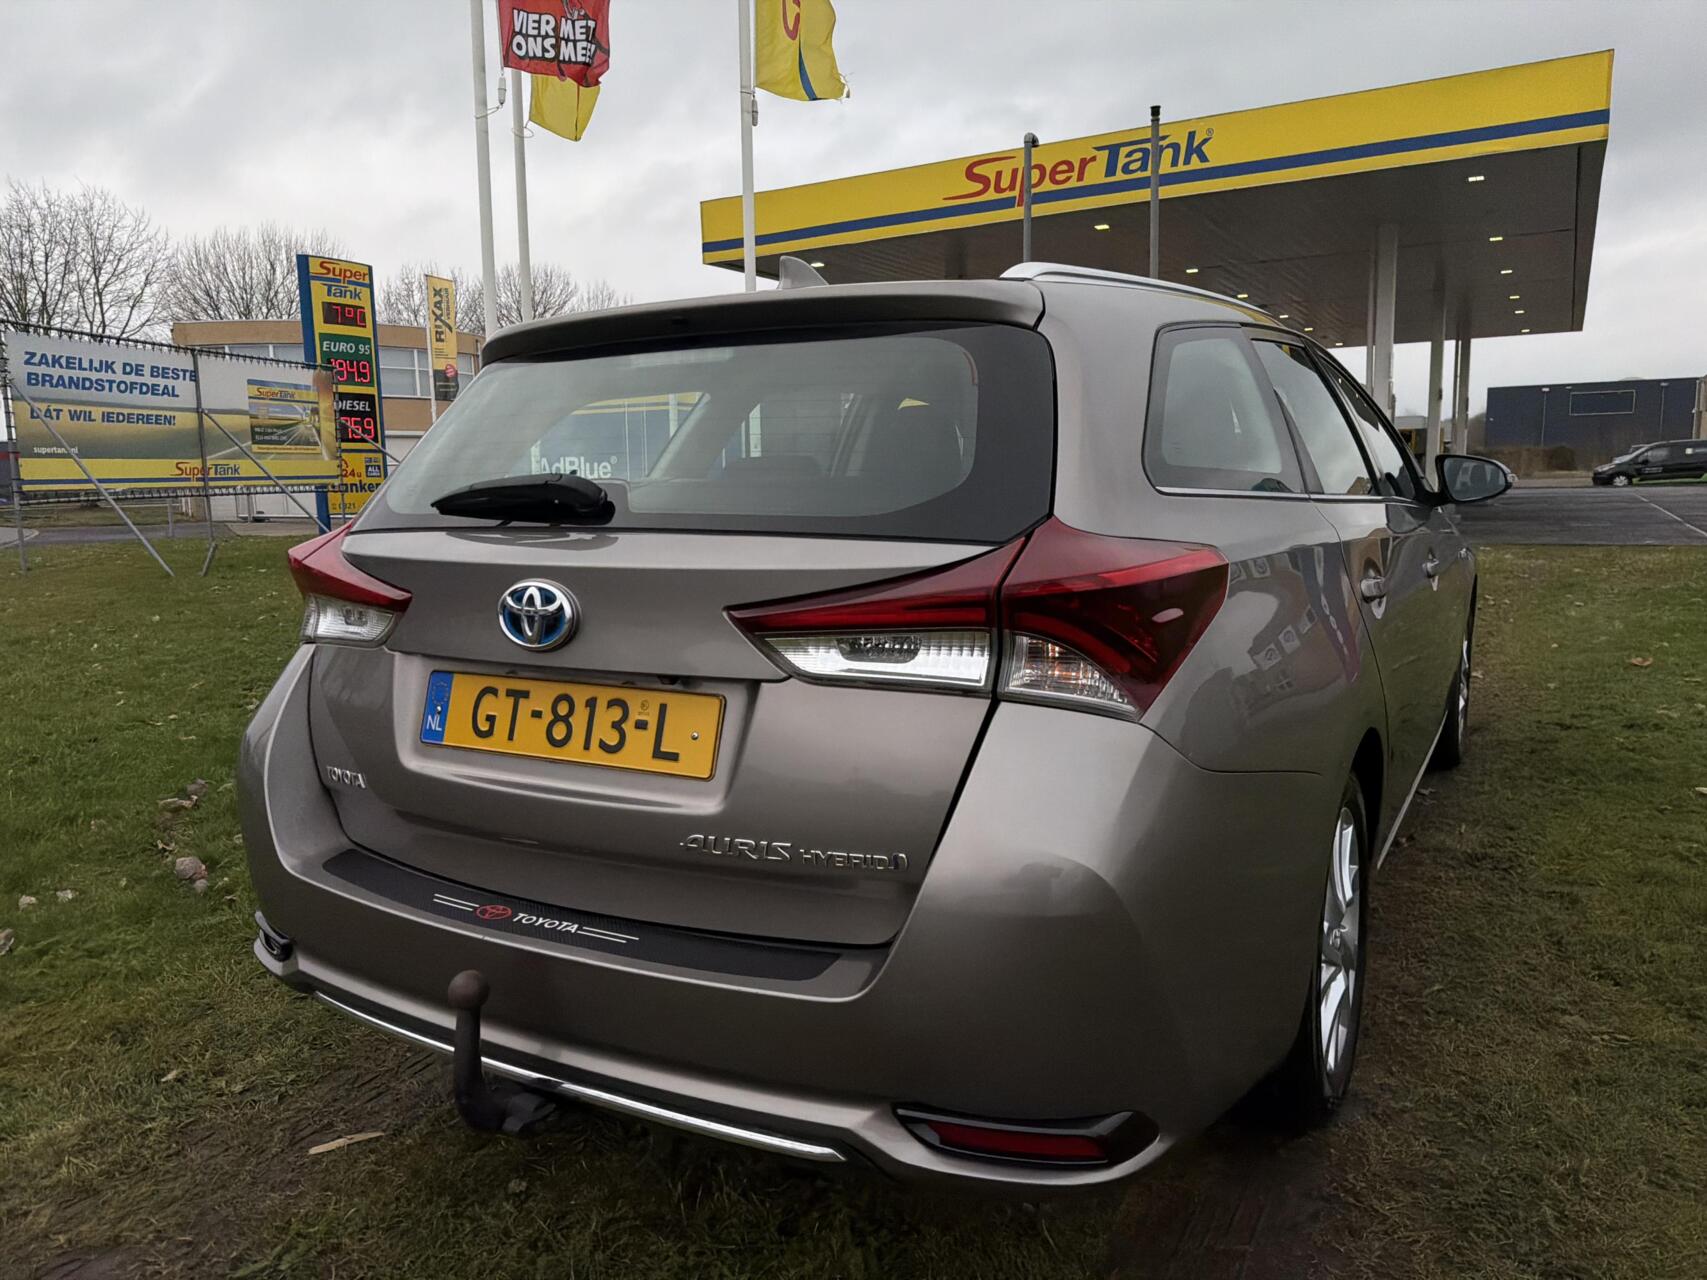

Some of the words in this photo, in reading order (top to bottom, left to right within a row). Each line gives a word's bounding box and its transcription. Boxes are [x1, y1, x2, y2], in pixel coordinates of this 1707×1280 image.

[513, 9, 556, 36] VIER
[560, 18, 596, 41] MET
[512, 34, 556, 59] ONS
[311, 260, 369, 285] Super
[320, 282, 363, 301] Tank
[322, 341, 356, 353] EURO
[358, 344, 371, 355] 95
[23, 351, 117, 374] ZAKELIJK
[122, 362, 145, 378] DE
[150, 365, 197, 382] BESTE
[26, 371, 180, 398] BRANDSTOFDEAL
[68, 409, 96, 422] WIL
[101, 411, 176, 426] IEDEREEN!
[541, 456, 612, 479] AdBlue
[426, 714, 442, 731] NL
[471, 686, 680, 762] GT-813-L
[326, 765, 366, 789] TOYOTA
[680, 834, 792, 861] AURIS
[800, 850, 890, 870] HYBRID
[513, 912, 579, 934] TOYOTA
